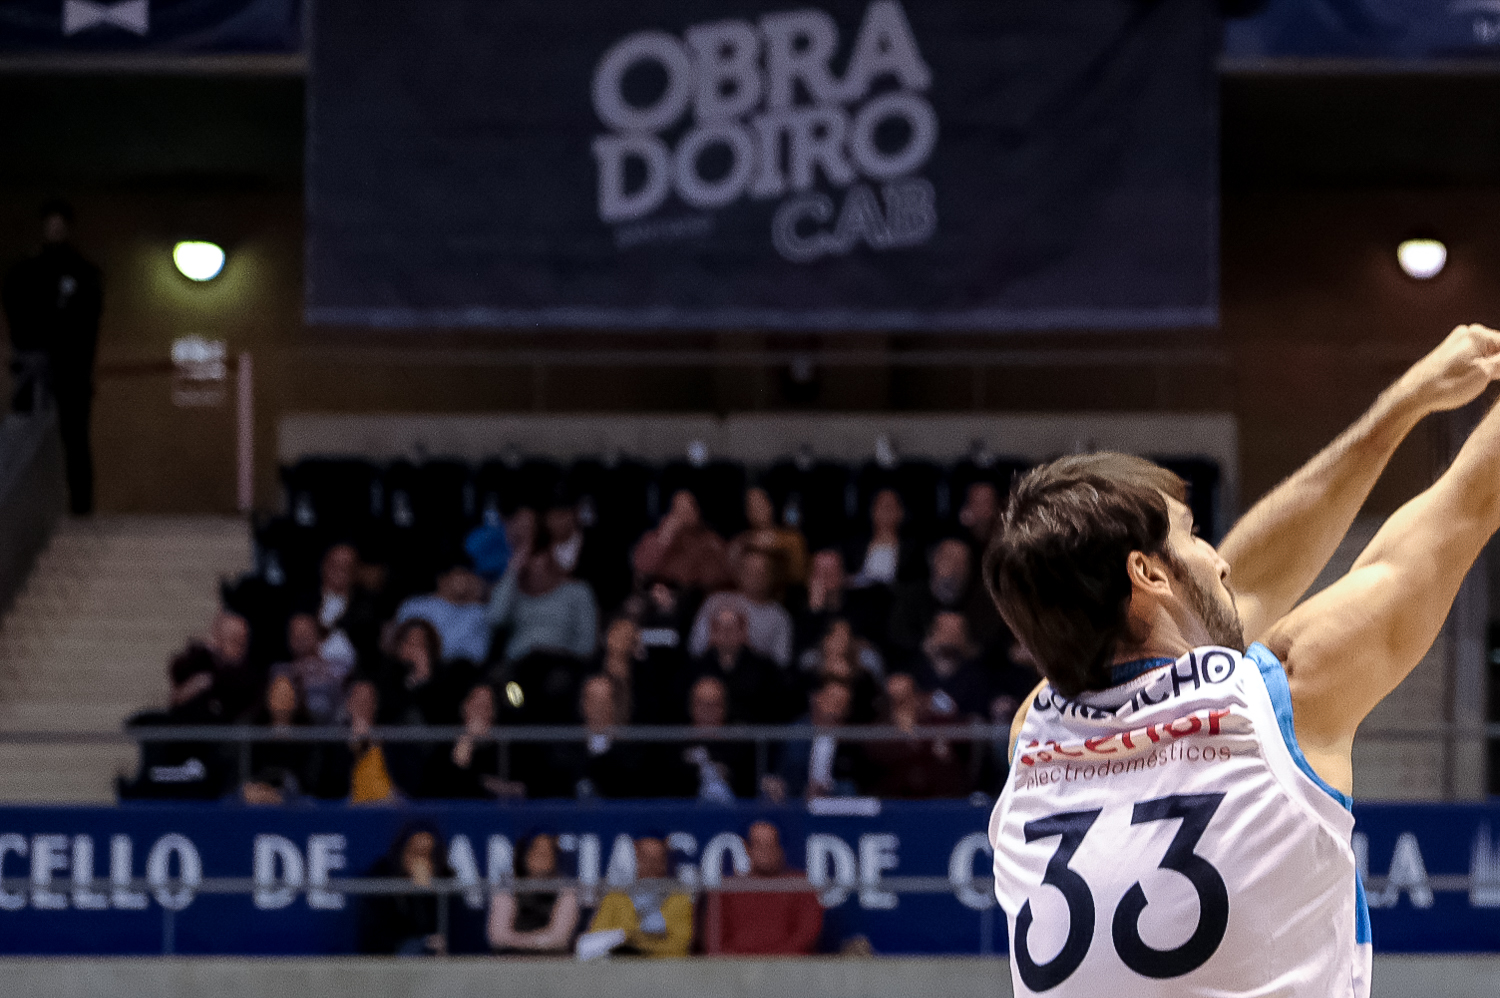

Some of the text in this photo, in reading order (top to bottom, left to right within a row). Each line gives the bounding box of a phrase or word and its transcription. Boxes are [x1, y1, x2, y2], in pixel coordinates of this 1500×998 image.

[590, 0, 934, 136] OBRA
[590, 90, 940, 223] DOIRO
[771, 176, 938, 263] CAB
[252, 833, 347, 910] DE
[805, 833, 900, 910] DE
[1013, 792, 1230, 994] 33
